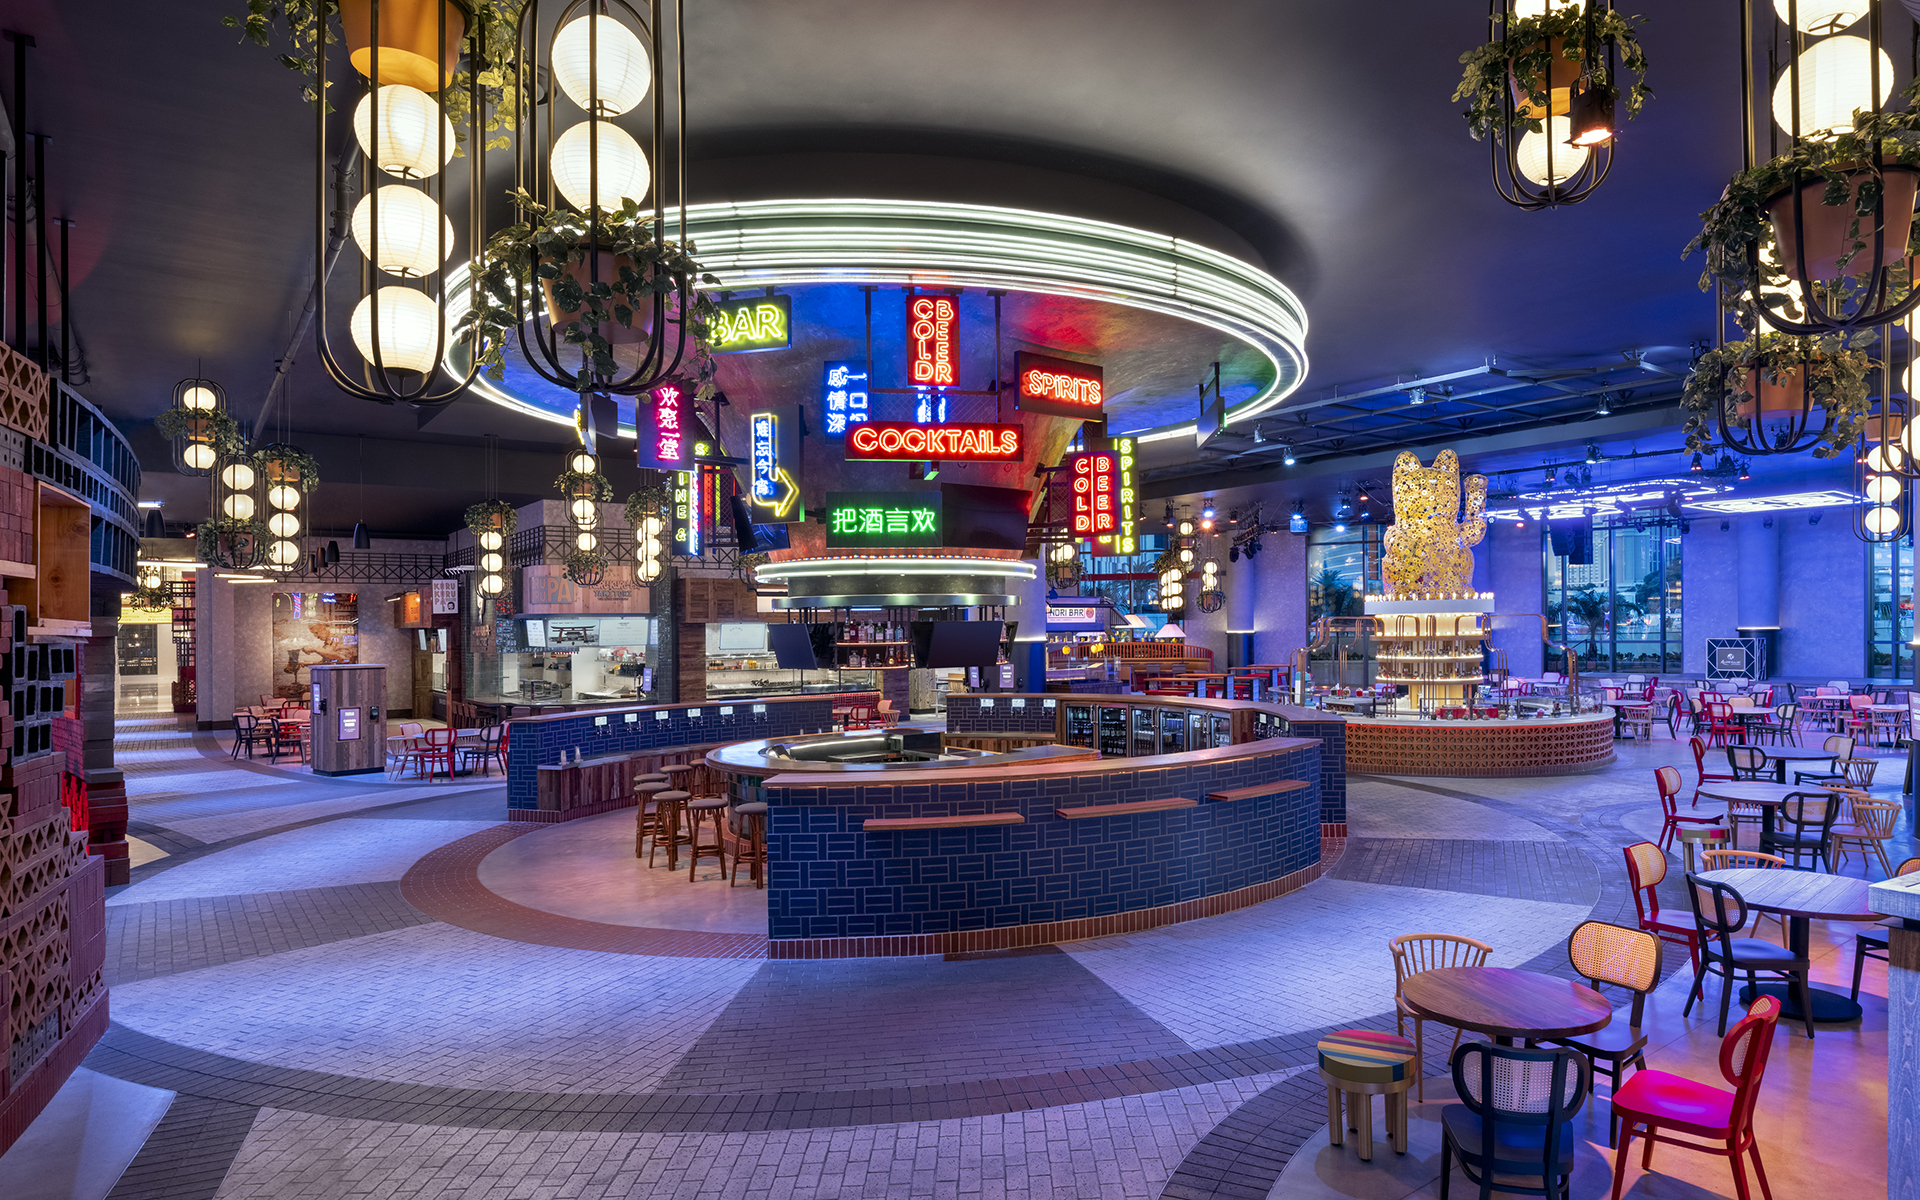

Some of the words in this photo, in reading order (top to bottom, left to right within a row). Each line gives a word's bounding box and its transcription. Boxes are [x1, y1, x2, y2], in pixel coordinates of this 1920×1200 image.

[706, 304, 783, 343] BAR
[913, 299, 935, 382] COLD
[936, 300, 954, 383] BEER
[657, 387, 681, 460] 欢聚一堂
[827, 366, 848, 433] 感情深
[675, 472, 687, 519] INE
[832, 507, 936, 534] 把酒言欢
[1074, 458, 1089, 531] COLD
[1096, 456, 1110, 530] BEER
[1120, 438, 1134, 553] SPIRITS
[1068, 608, 1084, 617] BAR
